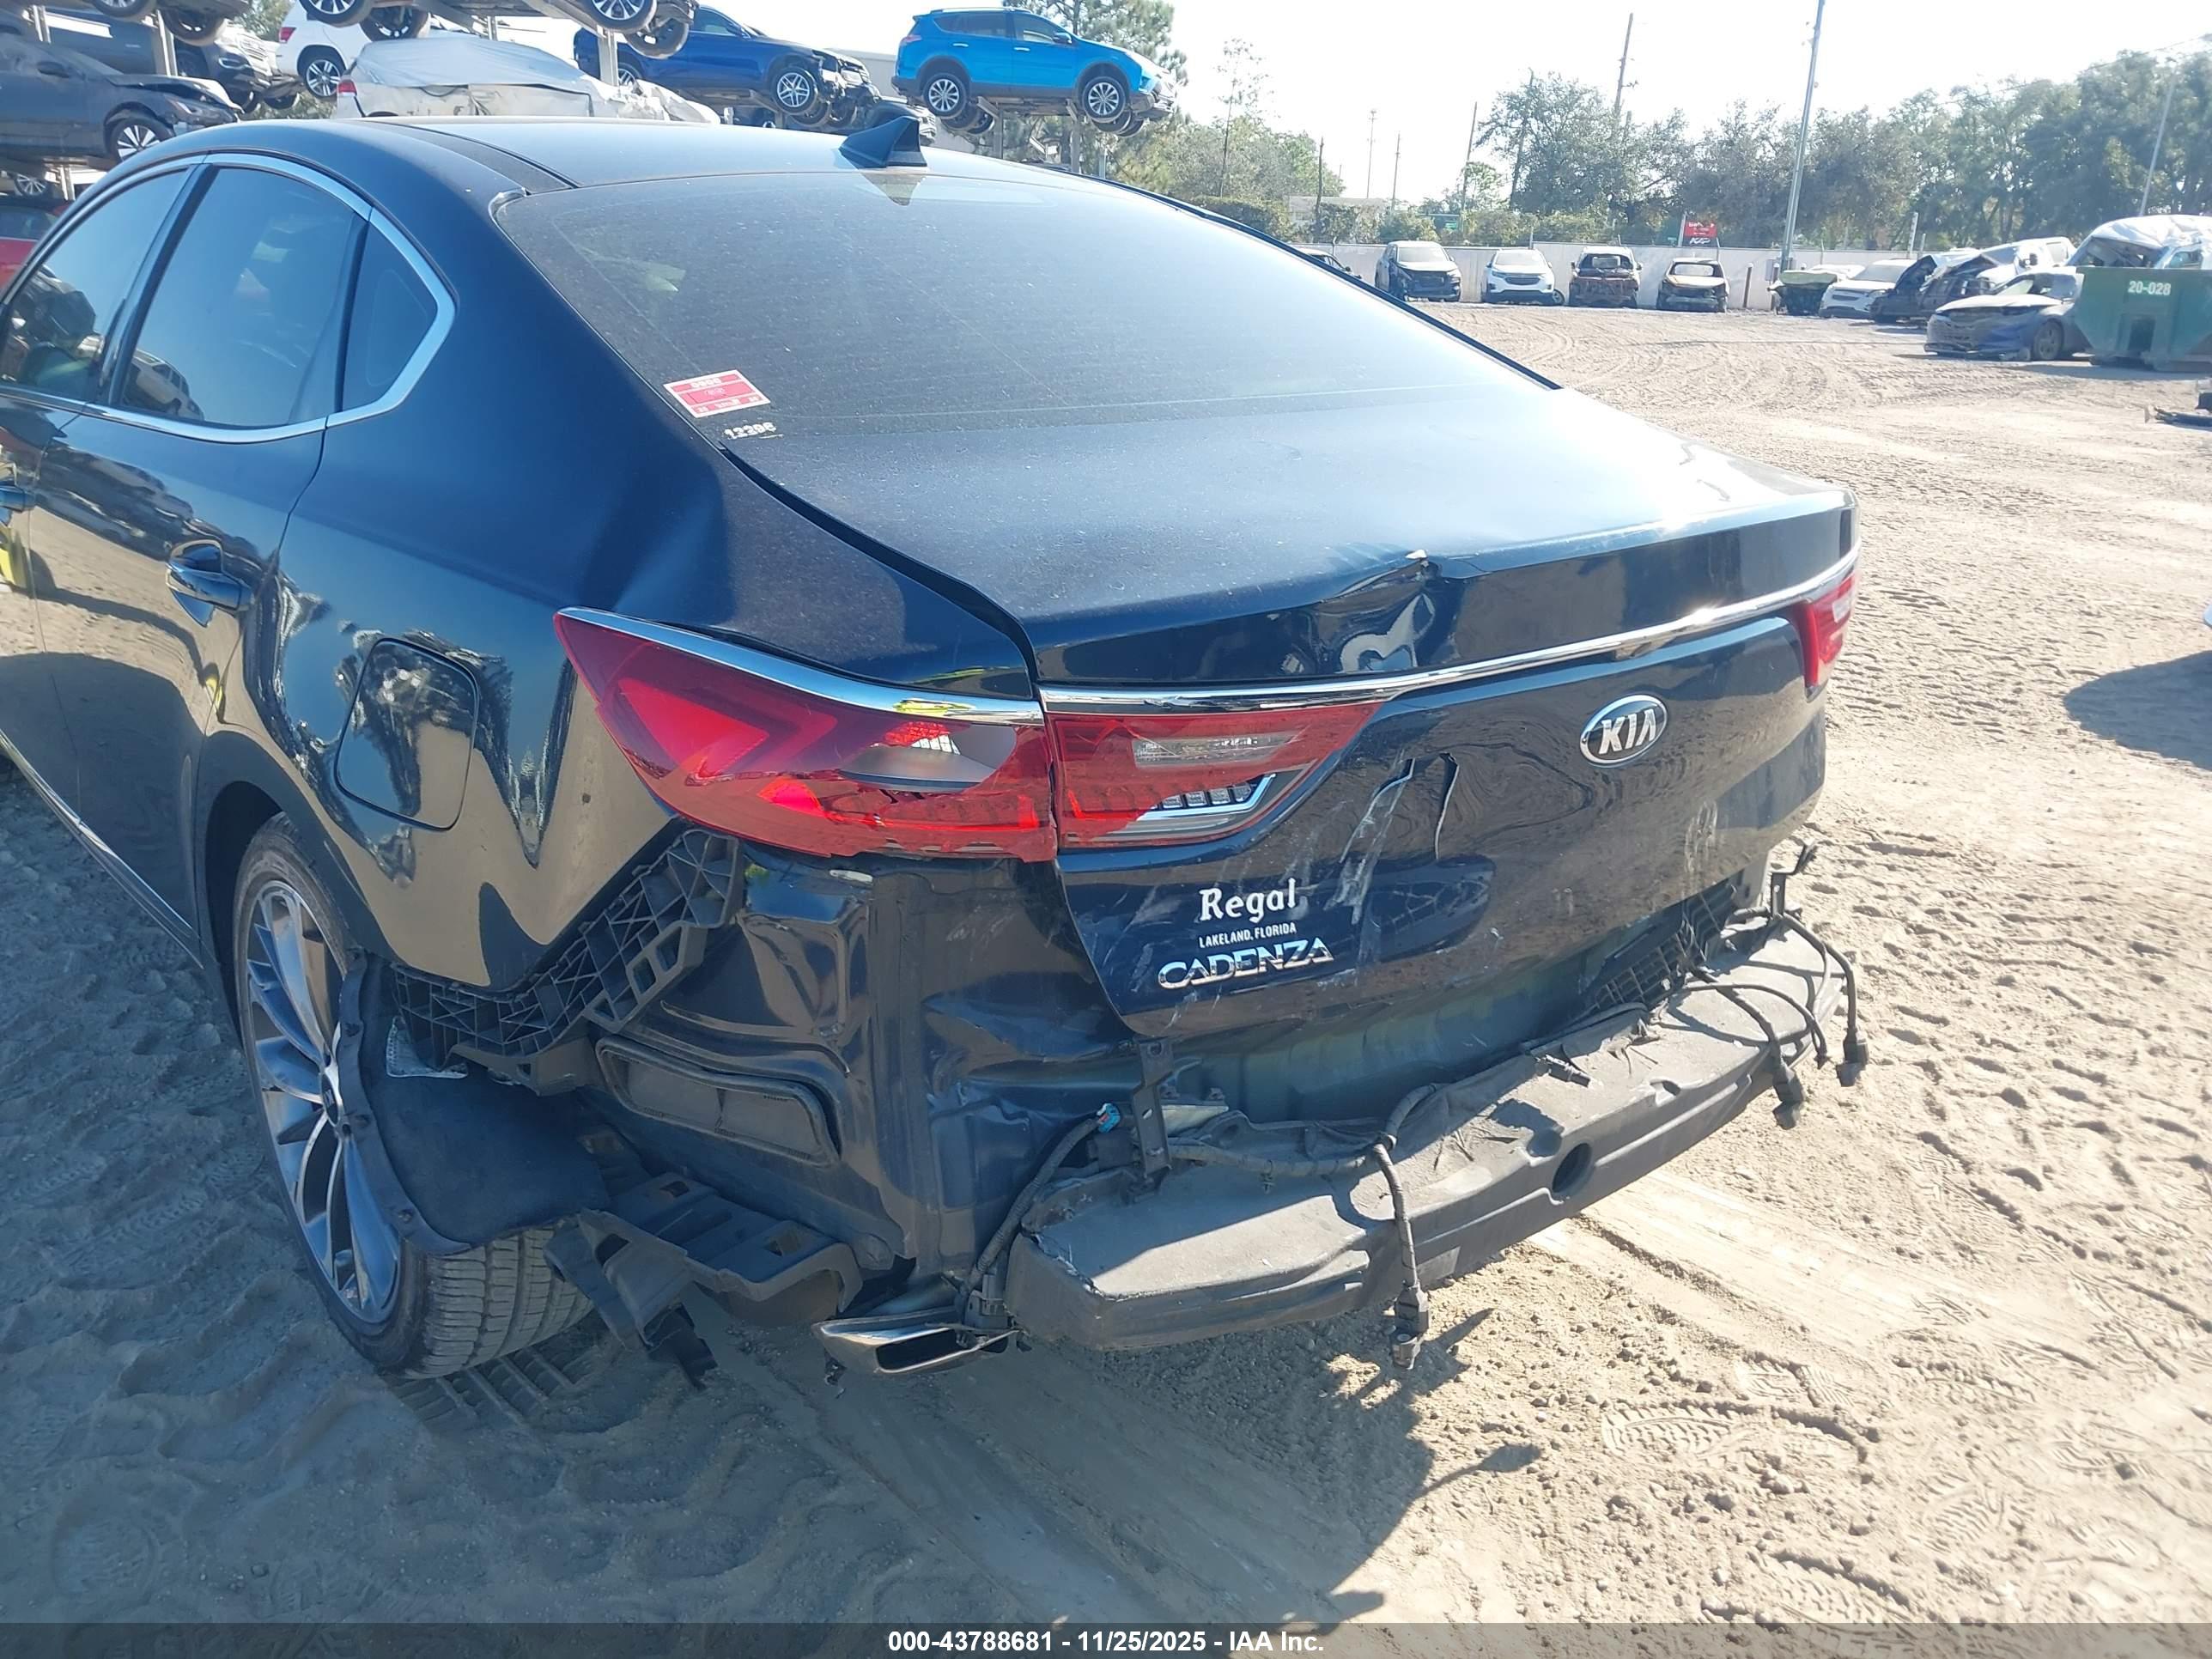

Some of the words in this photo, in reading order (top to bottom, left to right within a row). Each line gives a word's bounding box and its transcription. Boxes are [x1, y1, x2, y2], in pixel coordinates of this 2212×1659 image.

[2128, 280, 2172, 296] 20-028
[1598, 708, 1657, 755] KIA
[1199, 878, 1296, 923] Regal
[1255, 922, 1297, 939] FLORIDA
[1158, 937, 1334, 989] CADENZA
